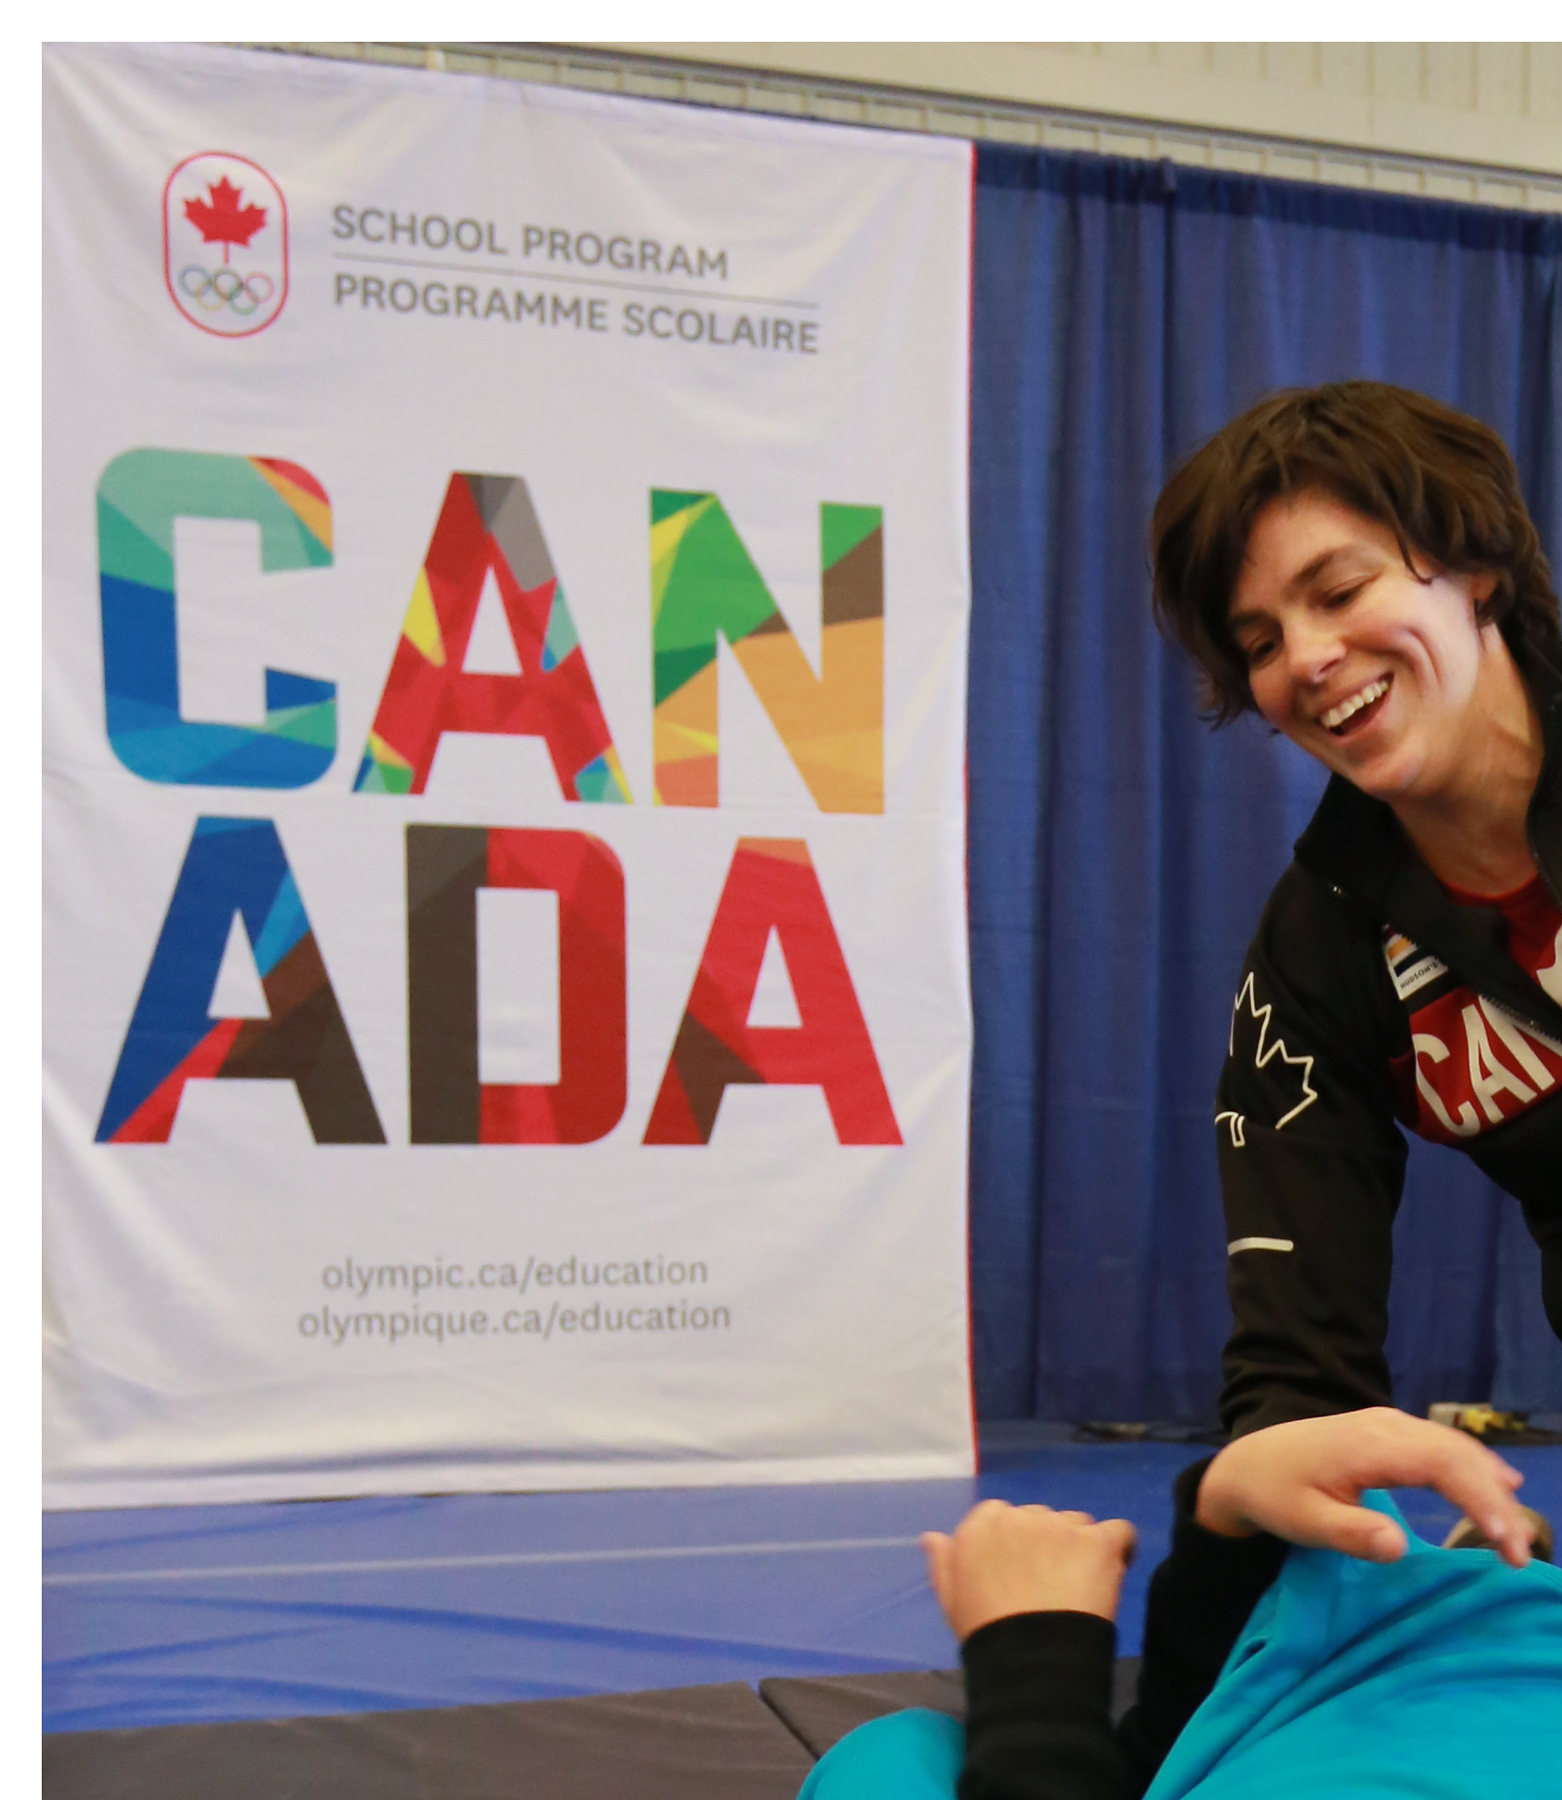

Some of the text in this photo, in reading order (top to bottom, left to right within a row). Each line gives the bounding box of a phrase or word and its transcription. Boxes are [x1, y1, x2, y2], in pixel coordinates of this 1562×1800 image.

[331, 204, 729, 281] SCHOOL PROGRAM
[333, 272, 820, 355] PROGRAMME SCOLAIRE
[96, 446, 885, 816] CAN
[92, 815, 906, 1147] ADA
[321, 1255, 709, 1298] olympic.ca/education
[298, 1300, 731, 1345] olympique.ca/education
